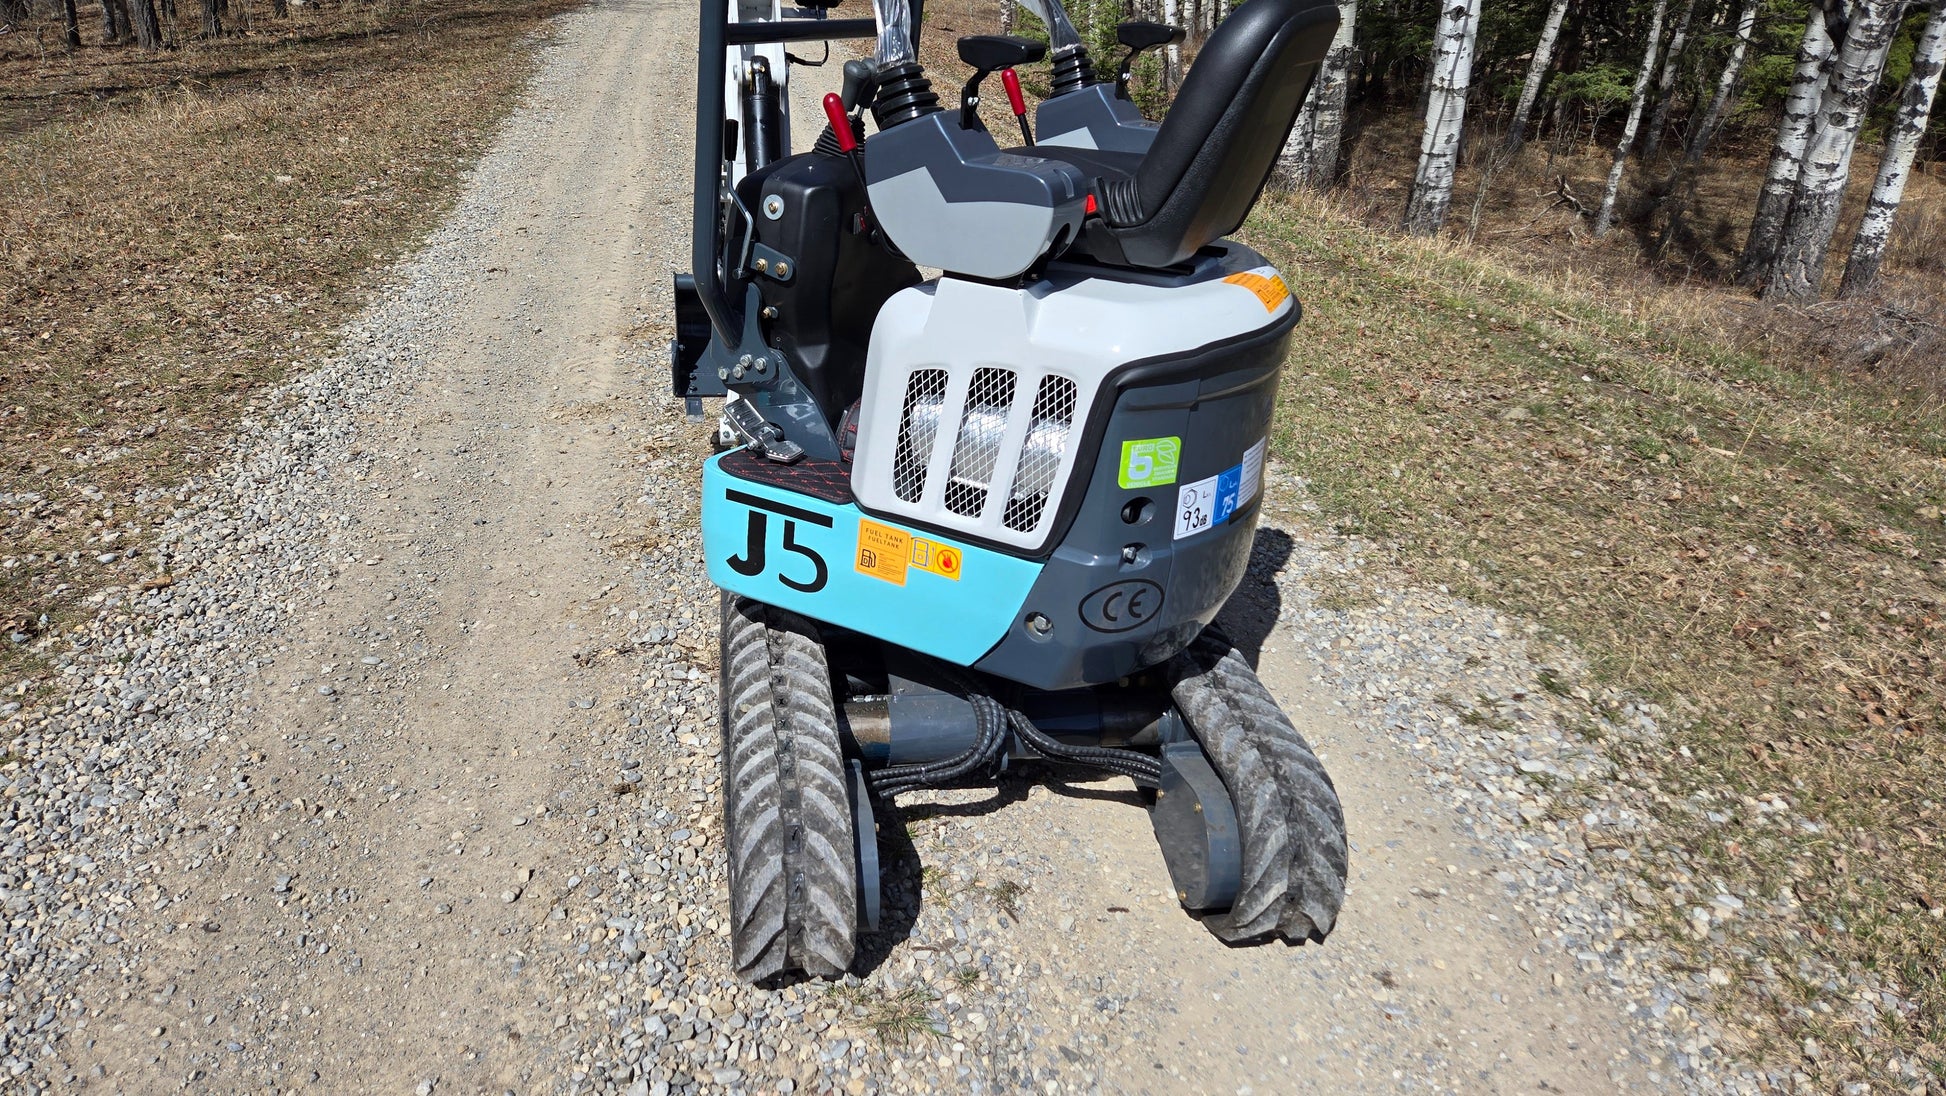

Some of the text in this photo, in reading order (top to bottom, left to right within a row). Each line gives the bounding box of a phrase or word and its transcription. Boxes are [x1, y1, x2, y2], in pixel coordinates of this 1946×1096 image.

[1128, 445, 1154, 480] 5
[1222, 493, 1236, 516] 75
[726, 488, 833, 593] J5
[866, 528, 903, 544] FUEL TANK
[868, 535, 899, 549] FUELTANK
[1103, 588, 1147, 622] CE
